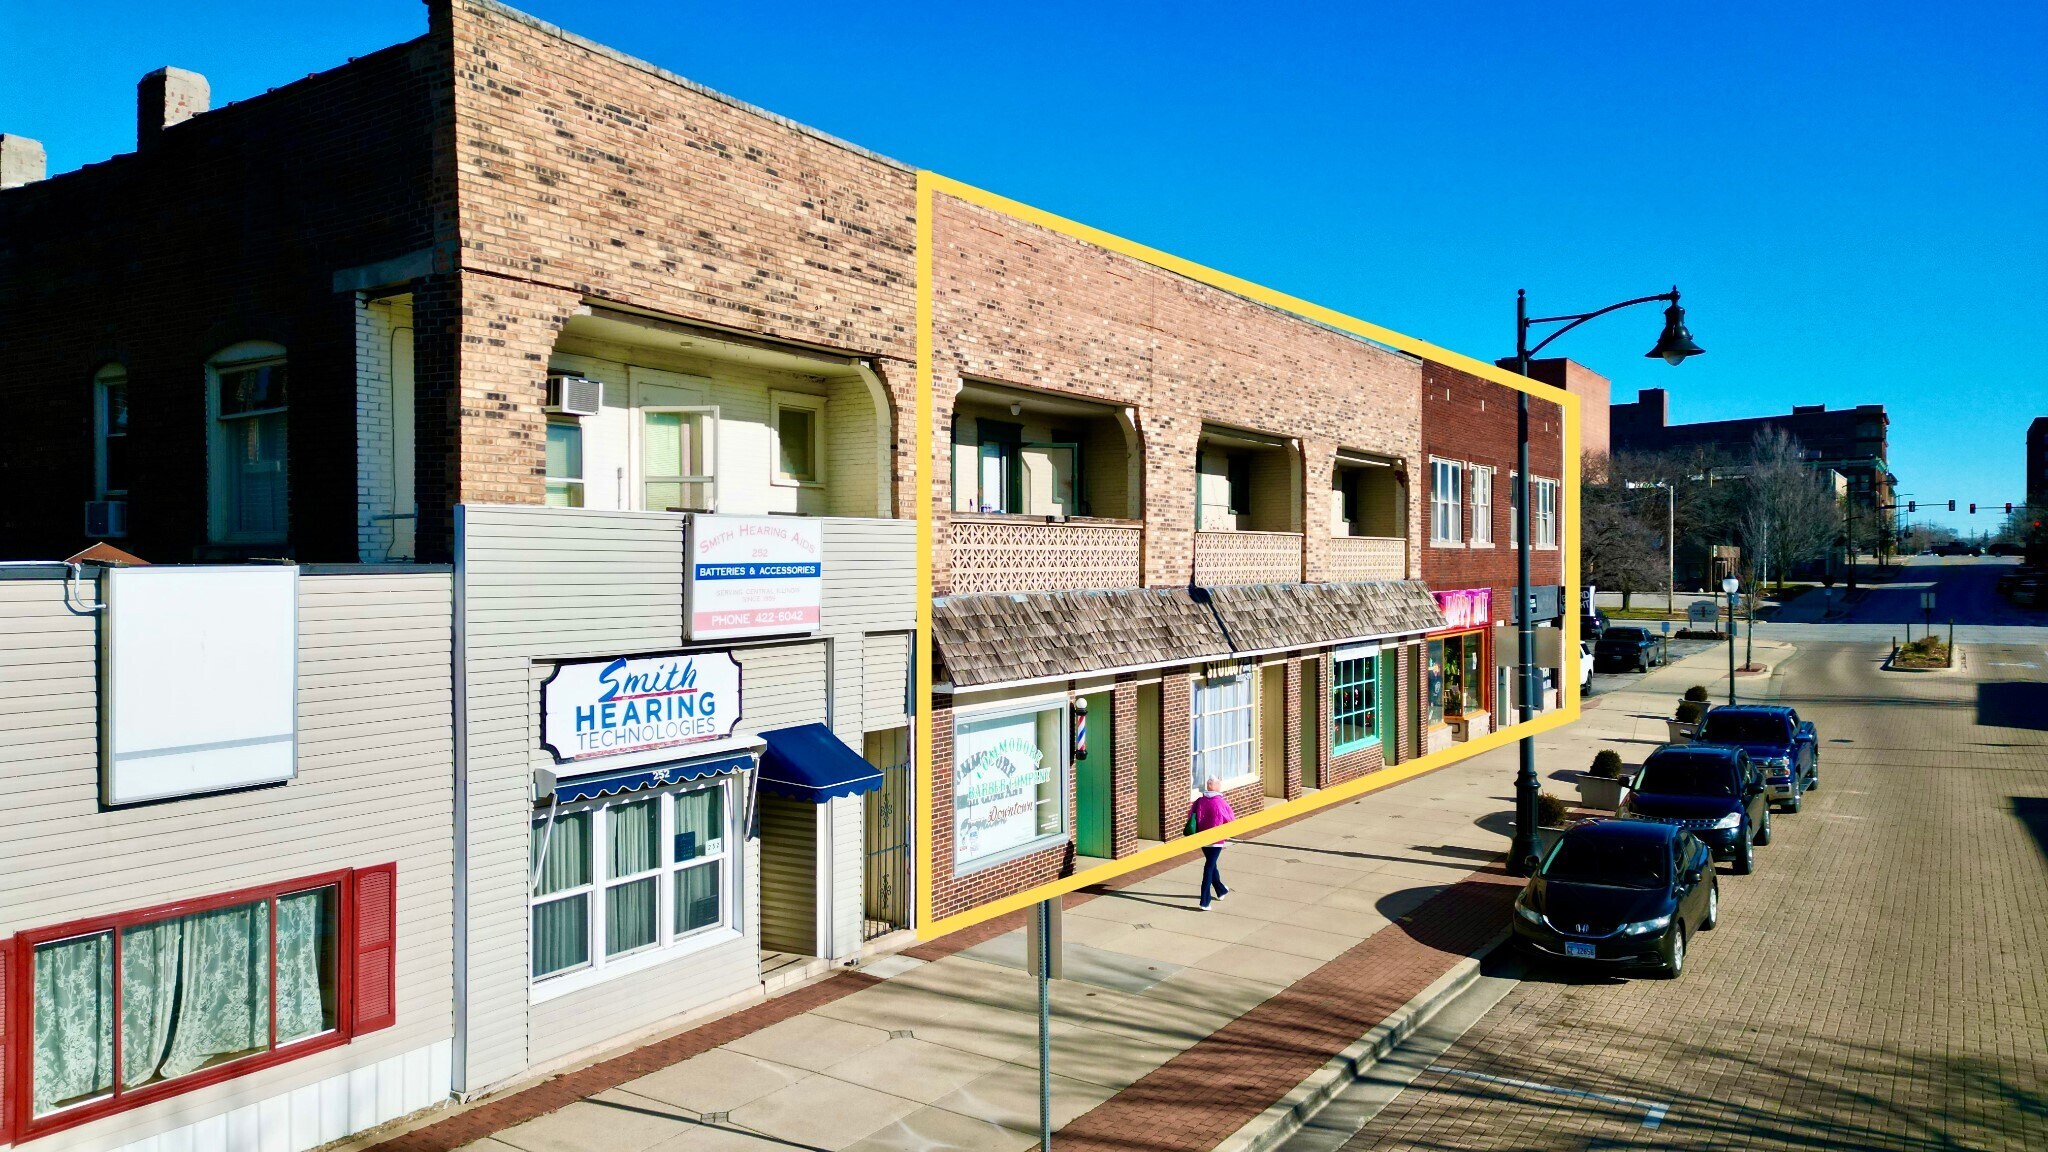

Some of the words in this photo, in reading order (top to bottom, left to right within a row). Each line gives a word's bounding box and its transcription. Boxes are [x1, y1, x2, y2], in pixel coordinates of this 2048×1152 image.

[752, 548, 768, 558] 252
[699, 566, 746, 577] BATTERIES
[749, 566, 756, 575] &
[759, 565, 816, 575] ACCESSORIES
[711, 613, 750, 627] PHONE
[754, 610, 804, 623] 422-6042
[599, 657, 698, 701] Smith
[575, 691, 716, 732] HEARING
[576, 717, 716, 750] TECHNOLOGIES
[653, 769, 670, 780] 252
[707, 842, 720, 851] 252
